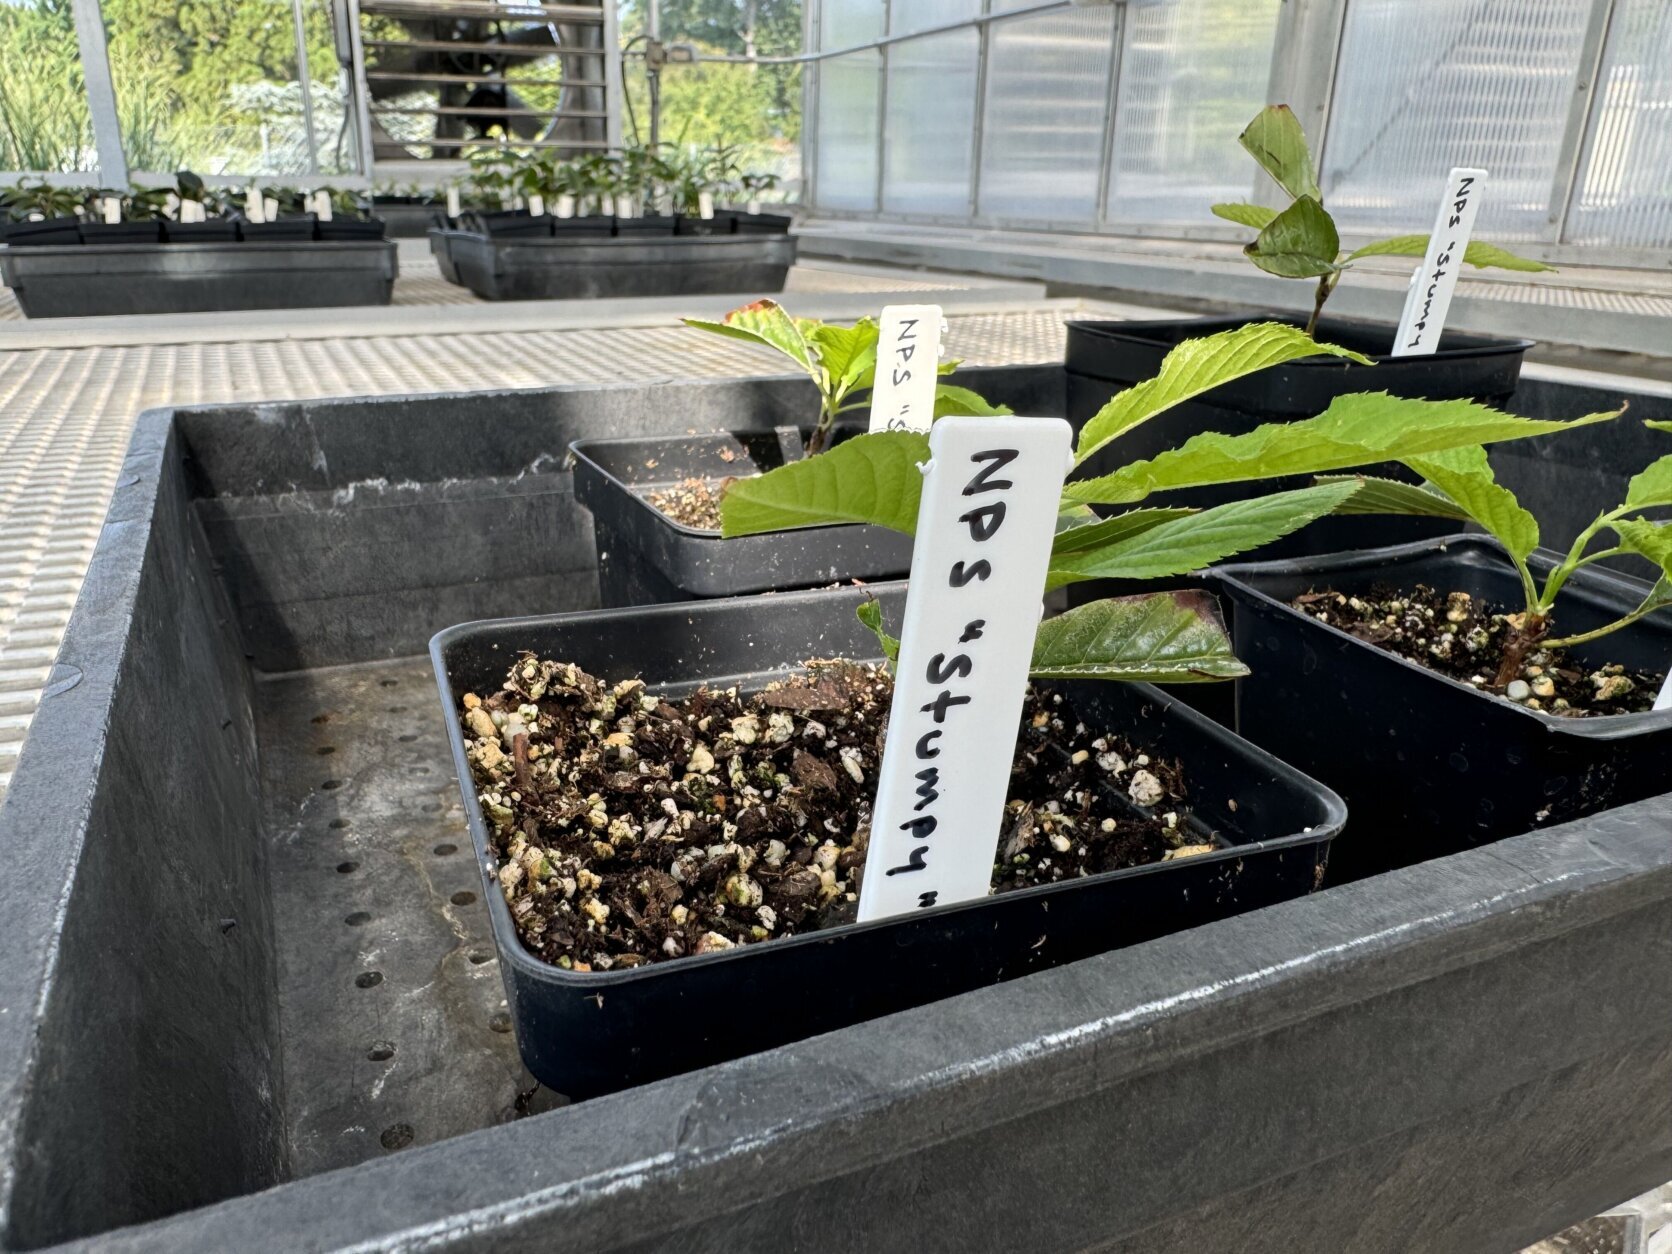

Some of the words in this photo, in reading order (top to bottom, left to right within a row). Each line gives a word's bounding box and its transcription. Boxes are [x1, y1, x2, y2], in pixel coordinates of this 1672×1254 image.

[1449, 177, 1475, 229] NPS
[892, 319, 919, 387] NPS
[949, 448, 1020, 589] NPS
[885, 618, 985, 908] "Stumpy"
